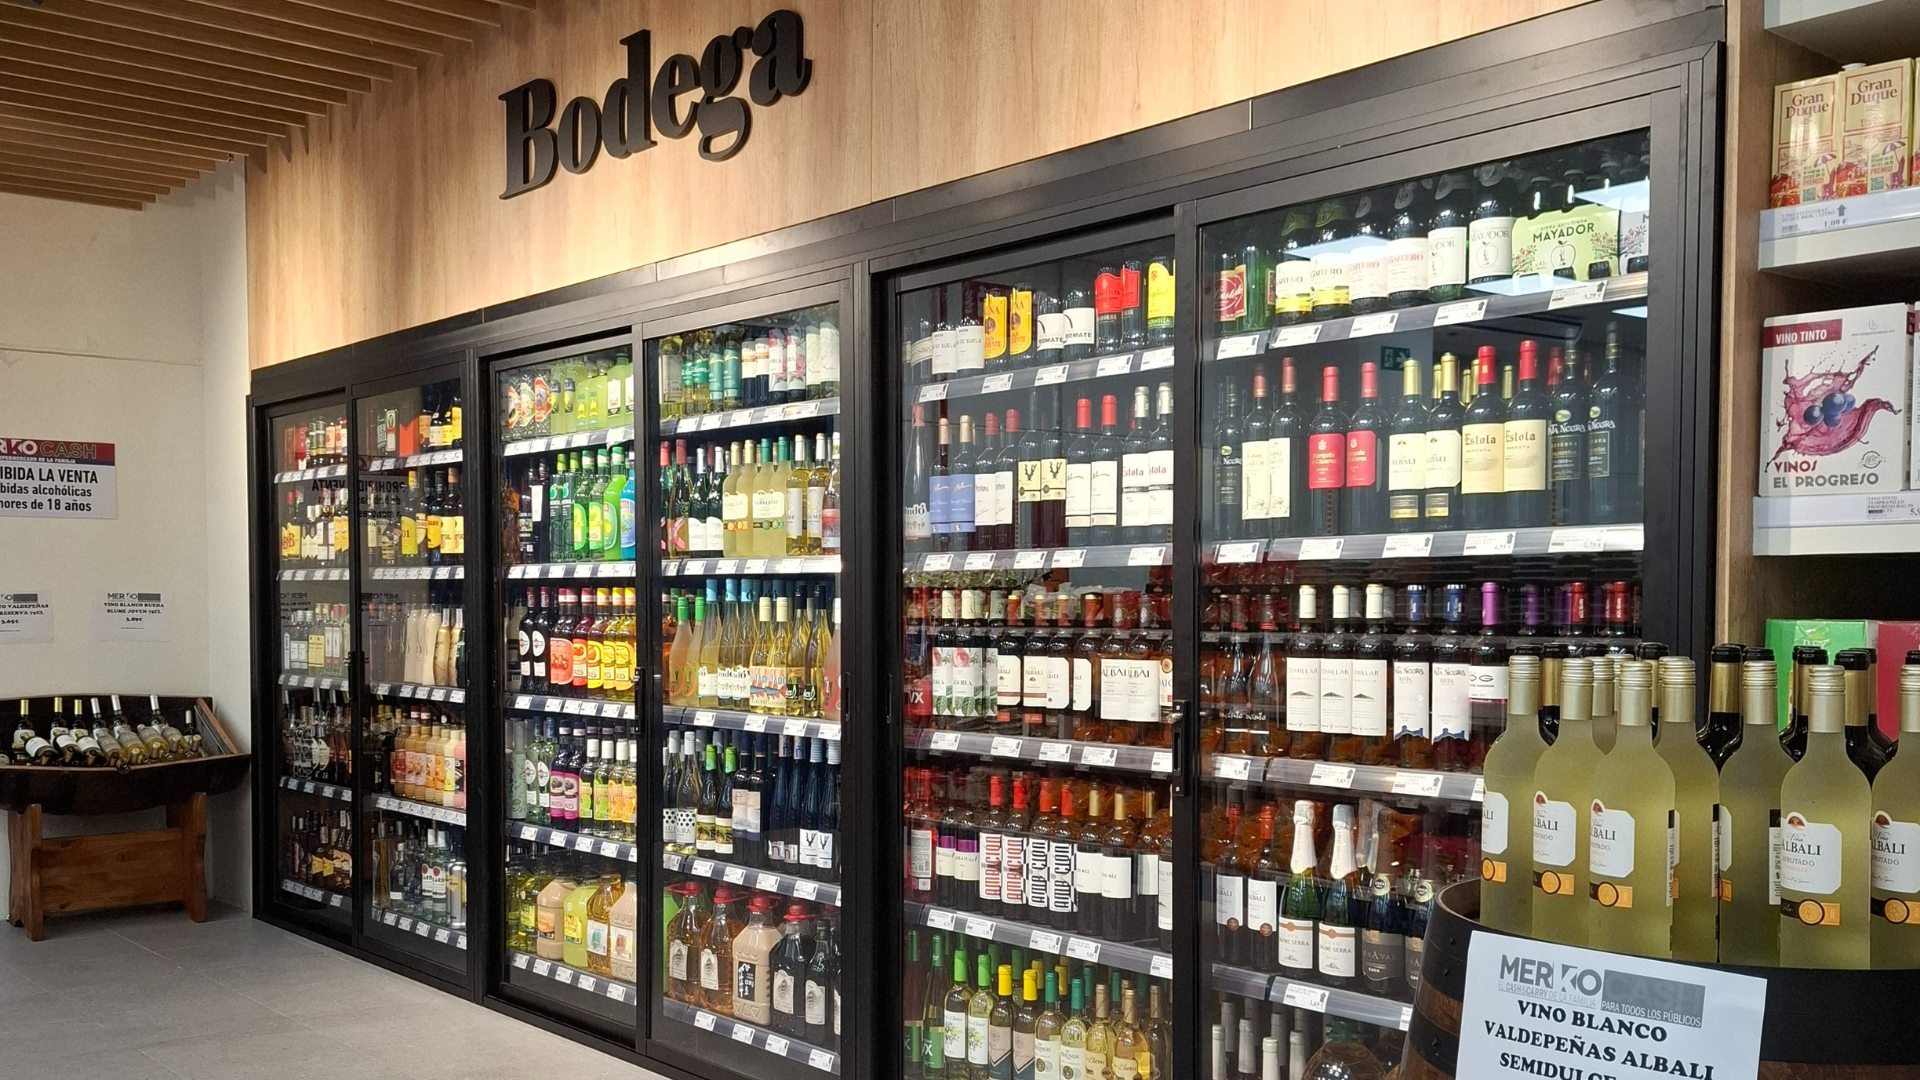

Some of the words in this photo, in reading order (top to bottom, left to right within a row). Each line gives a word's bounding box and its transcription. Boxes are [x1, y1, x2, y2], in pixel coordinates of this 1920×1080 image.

[1857, 79, 1892, 94] Gran
[499, 9, 812, 200] Bodega
[1791, 93, 1824, 107] Gran
[1851, 88, 1897, 106] Duque
[1785, 102, 1829, 119] Duque
[1824, 219, 1841, 228] 1,09
[1533, 223, 1594, 243] MAYADOR
[1776, 331, 1798, 345] VINO
[1800, 329, 1827, 343] TINTO
[1464, 433, 1496, 446] Estola
[1505, 430, 1536, 443] Estola
[40, 441, 96, 459] CASH
[1774, 460, 1817, 473] VINOS
[39, 468, 55, 481] LA
[58, 469, 98, 484] VENTA
[1773, 477, 1788, 488] EL
[1795, 472, 1879, 488] PROGRESO
[0, 482, 29, 494] bidas
[32, 484, 92, 497] alcohólicas
[31, 499, 43, 510] de
[47, 498, 61, 510] 18
[64, 499, 92, 512] años
[1499, 954, 1602, 996] MERKO
[1518, 999, 1567, 1023] VINO
[1571, 1010, 1668, 1042] BLANCO
[1602, 1001, 1620, 1013] PARA
[1621, 1004, 1645, 1018] TODOS
[1647, 1008, 1661, 1020] LOS
[1663, 1009, 1702, 1028] PÚBLICOS
[1484, 1020, 1616, 1062] VALDEPEÑAS
[1621, 1050, 1715, 1080] ALBALI
